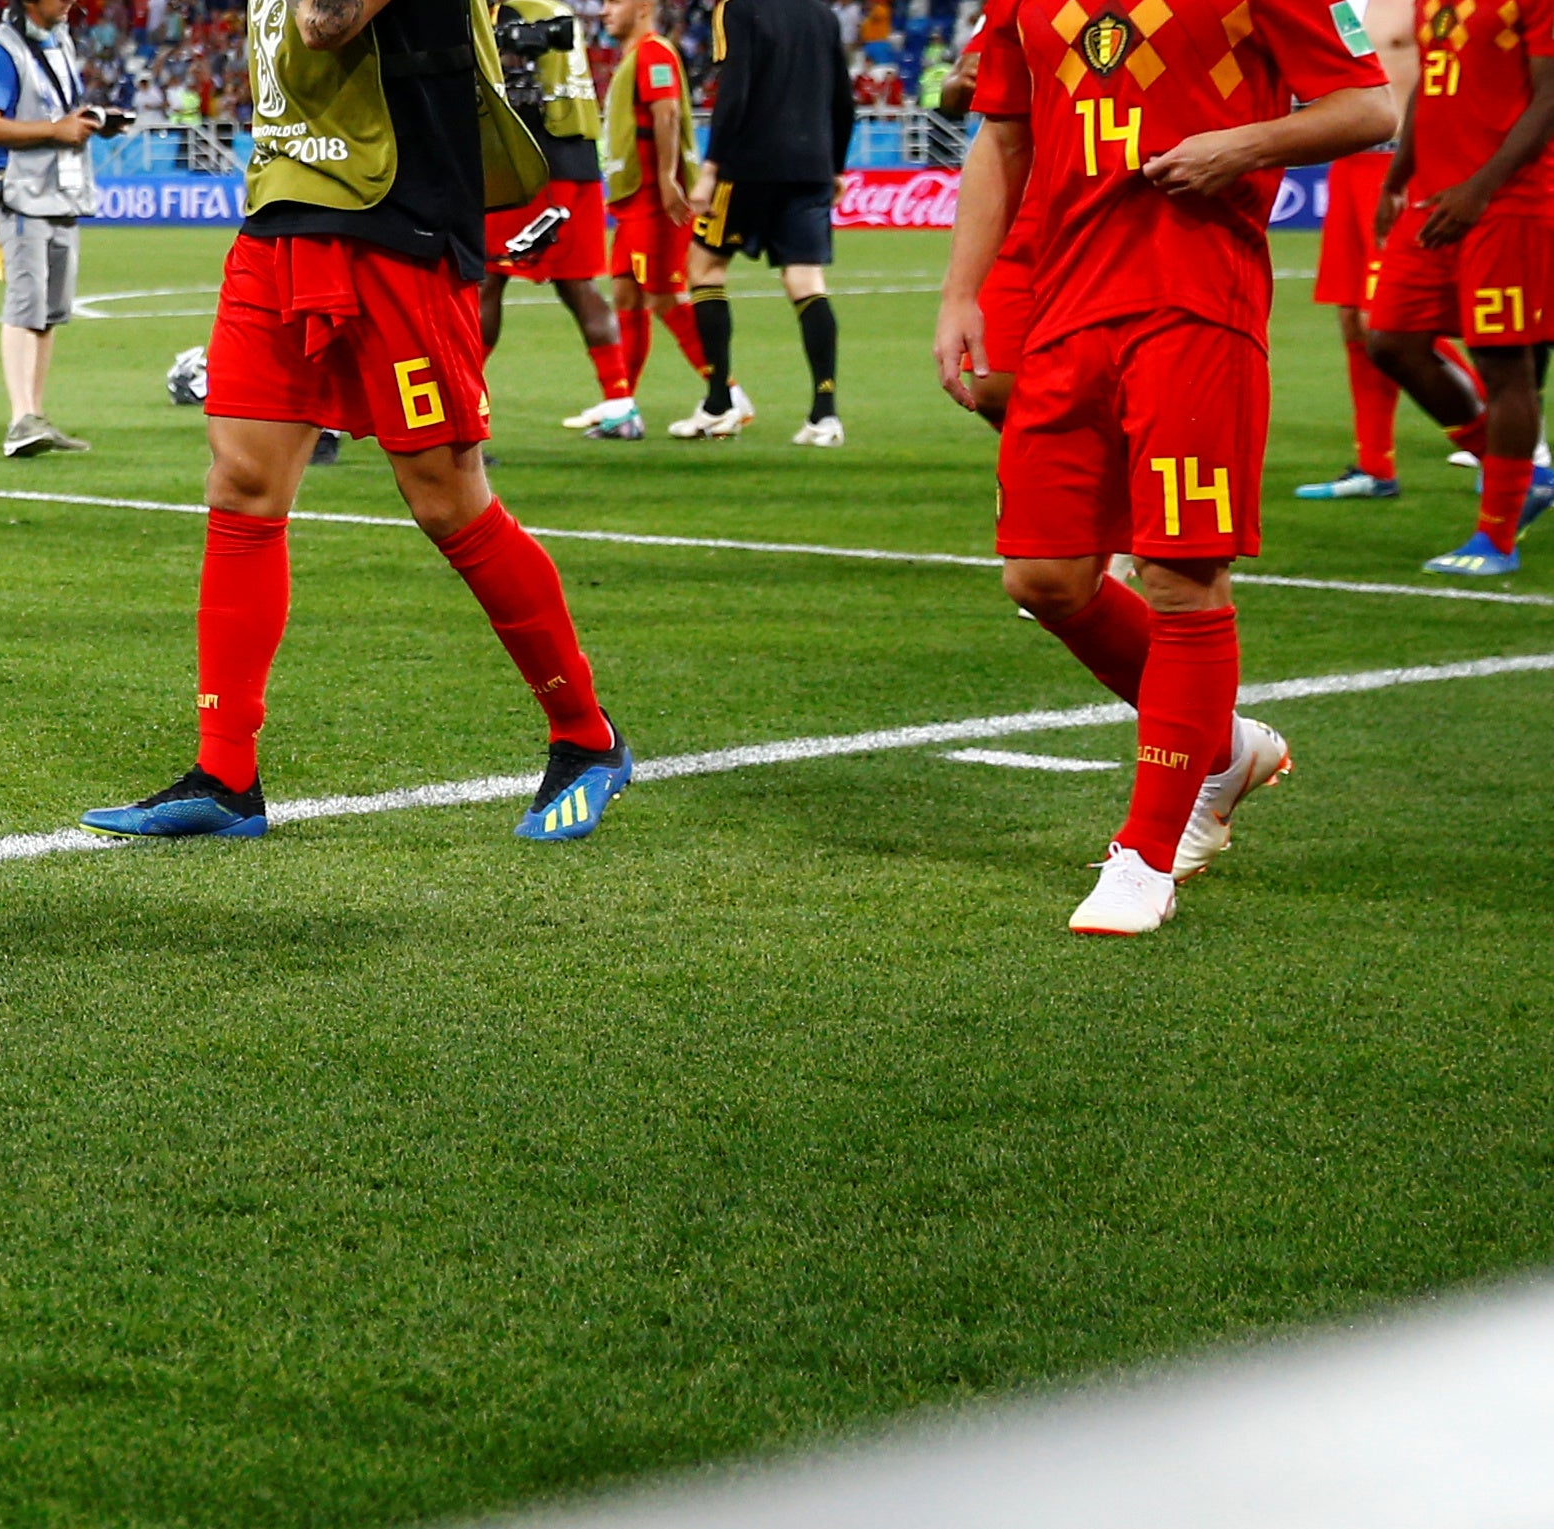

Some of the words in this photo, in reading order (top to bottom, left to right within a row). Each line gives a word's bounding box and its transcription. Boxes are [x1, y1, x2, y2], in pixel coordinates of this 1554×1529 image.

[1075, 97, 1143, 177] 14
[160, 184, 233, 219] FIFA
[1474, 286, 1524, 334] 21
[393, 356, 446, 429] 6
[1150, 456, 1233, 536] 14
